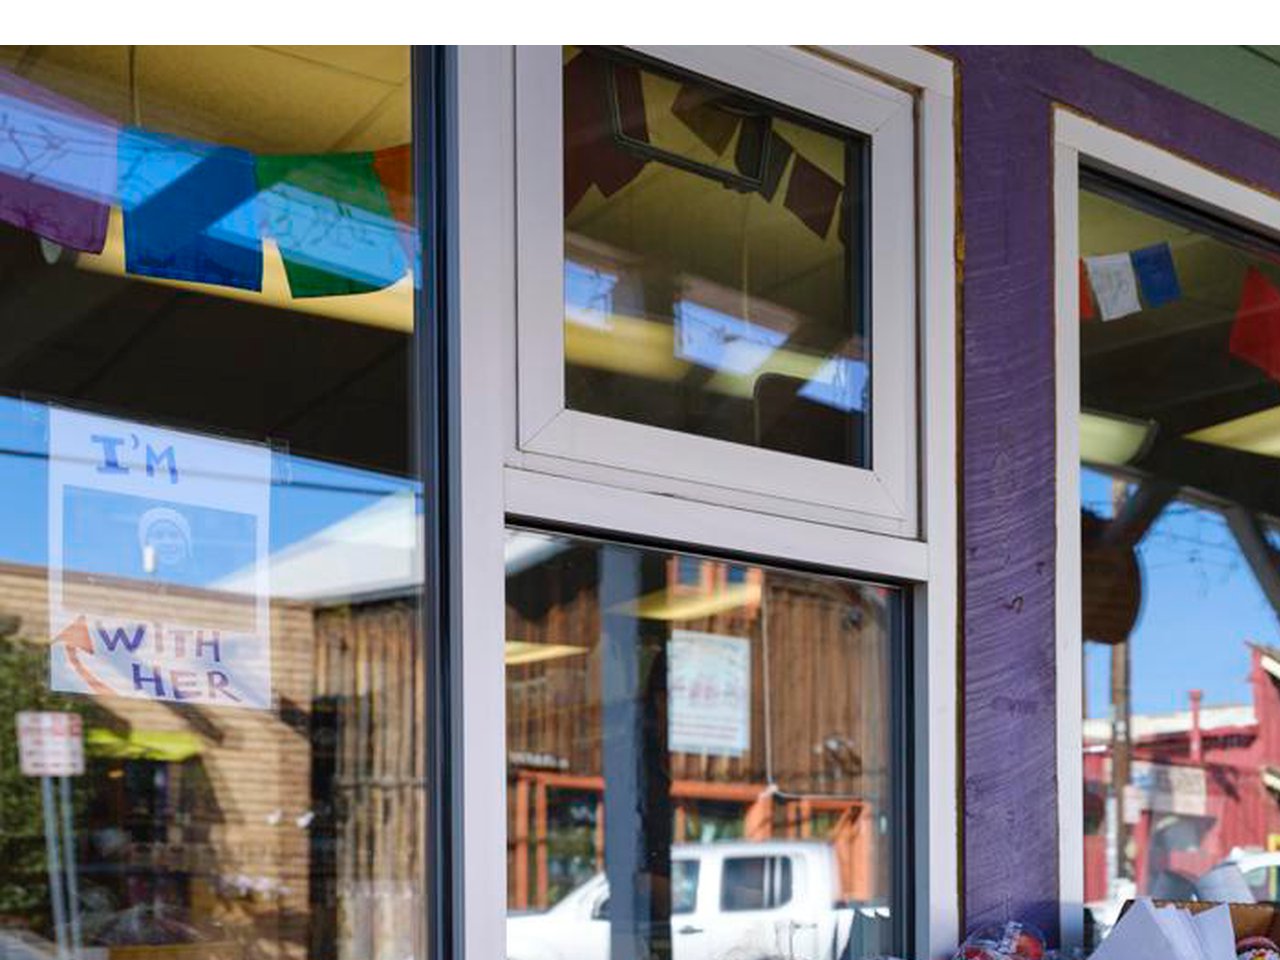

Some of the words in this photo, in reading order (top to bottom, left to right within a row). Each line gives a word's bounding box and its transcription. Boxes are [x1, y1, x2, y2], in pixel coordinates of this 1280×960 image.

[90, 433, 179, 485] I'M
[98, 623, 221, 662] WITH
[131, 663, 241, 702] HER
